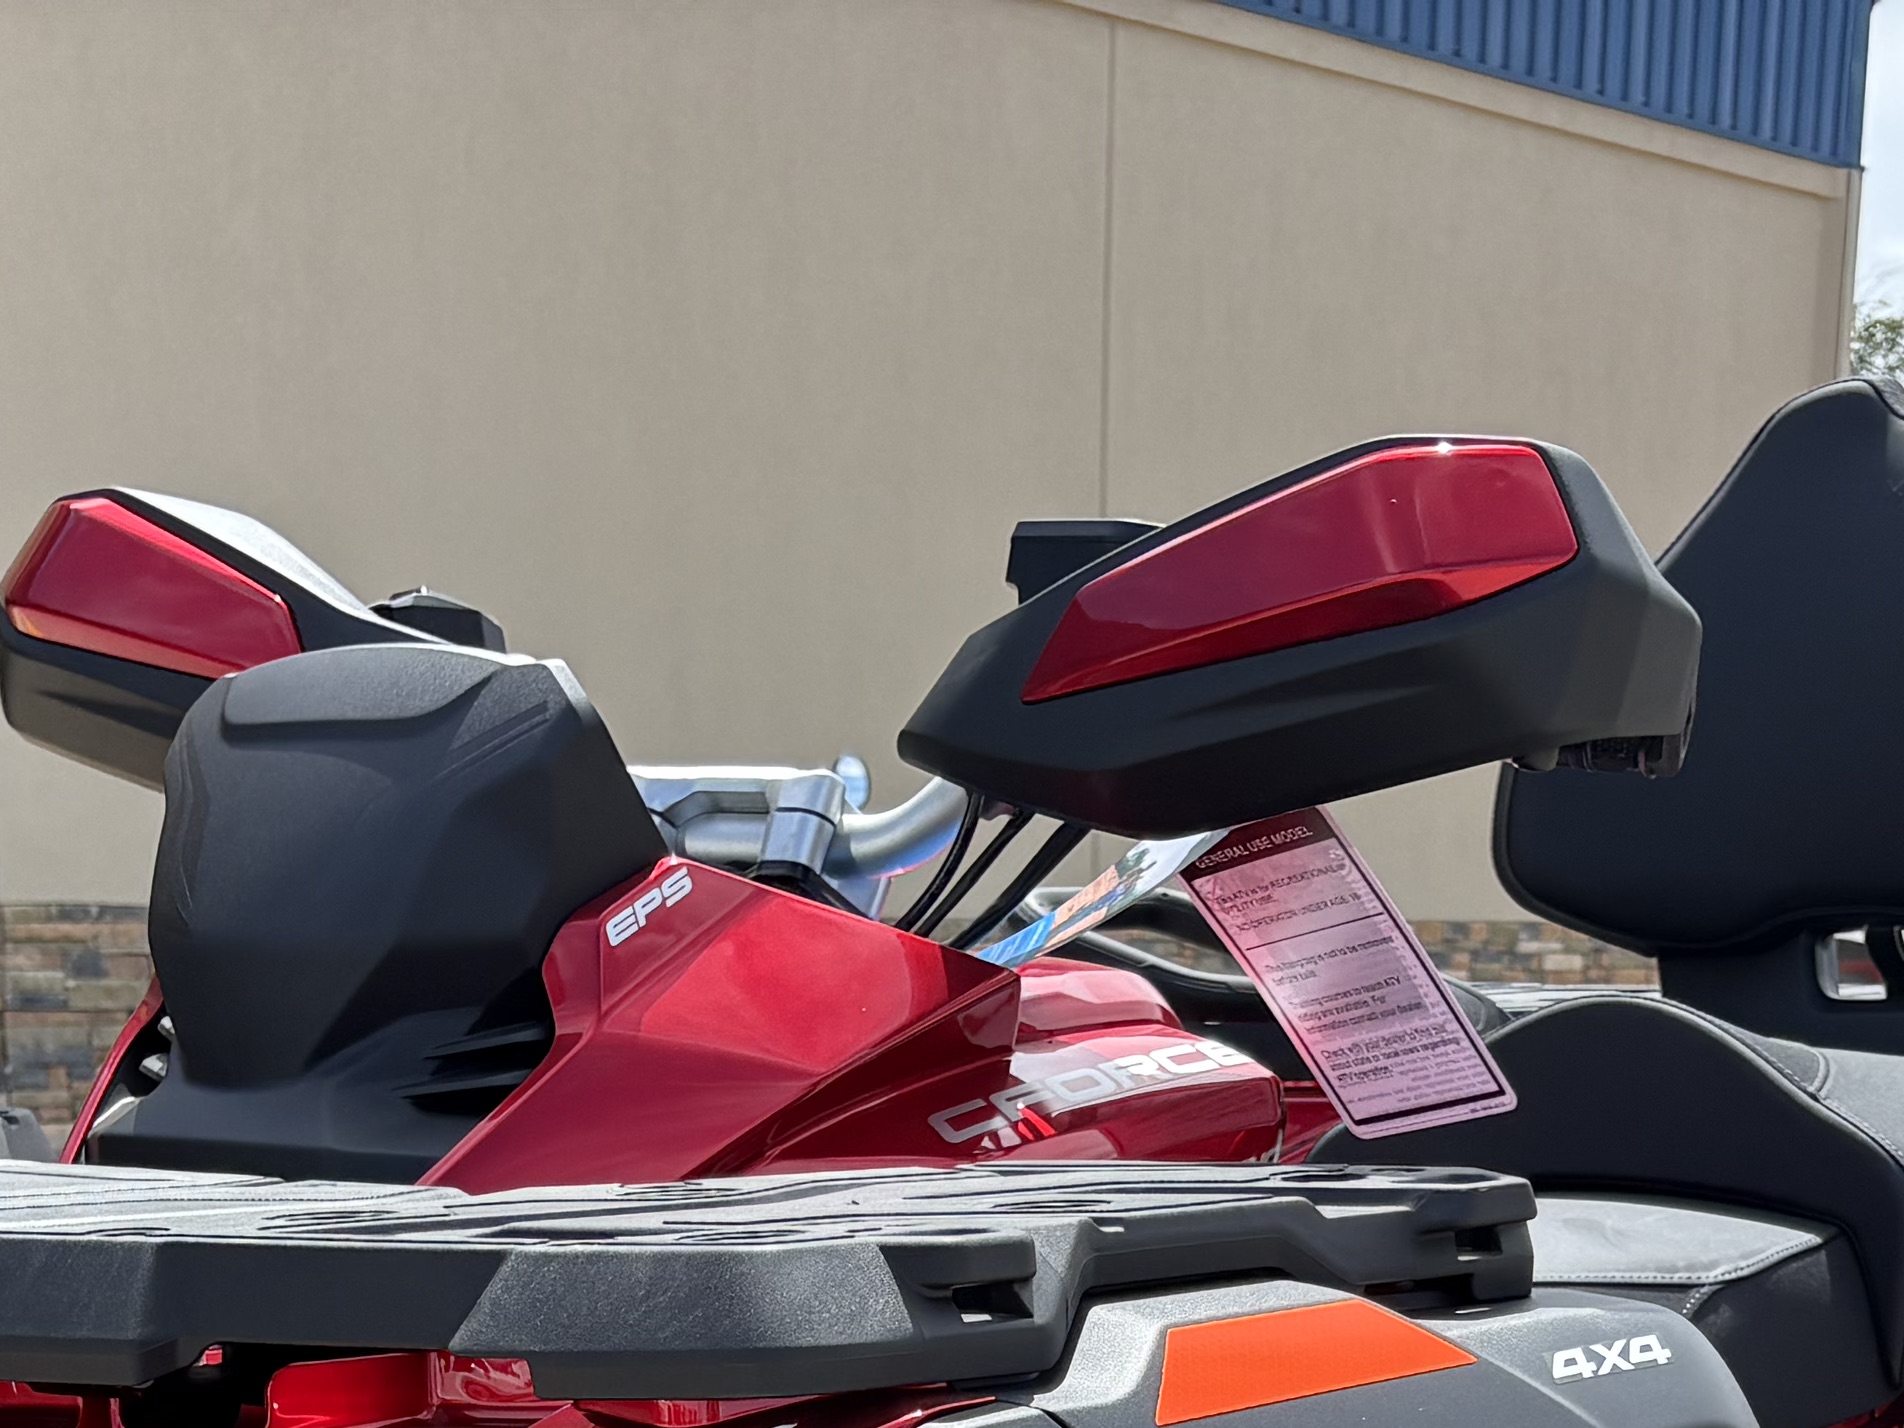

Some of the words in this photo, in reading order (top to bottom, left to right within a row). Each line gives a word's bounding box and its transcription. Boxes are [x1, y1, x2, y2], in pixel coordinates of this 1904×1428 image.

[1196, 843, 1249, 869] GENERAL
[1249, 836, 1271, 852] USE
[1273, 825, 1313, 845] MODEL
[605, 866, 693, 947] EPS
[927, 1041, 1256, 1144] CFORCE
[1552, 1334, 1672, 1379] 4X4
